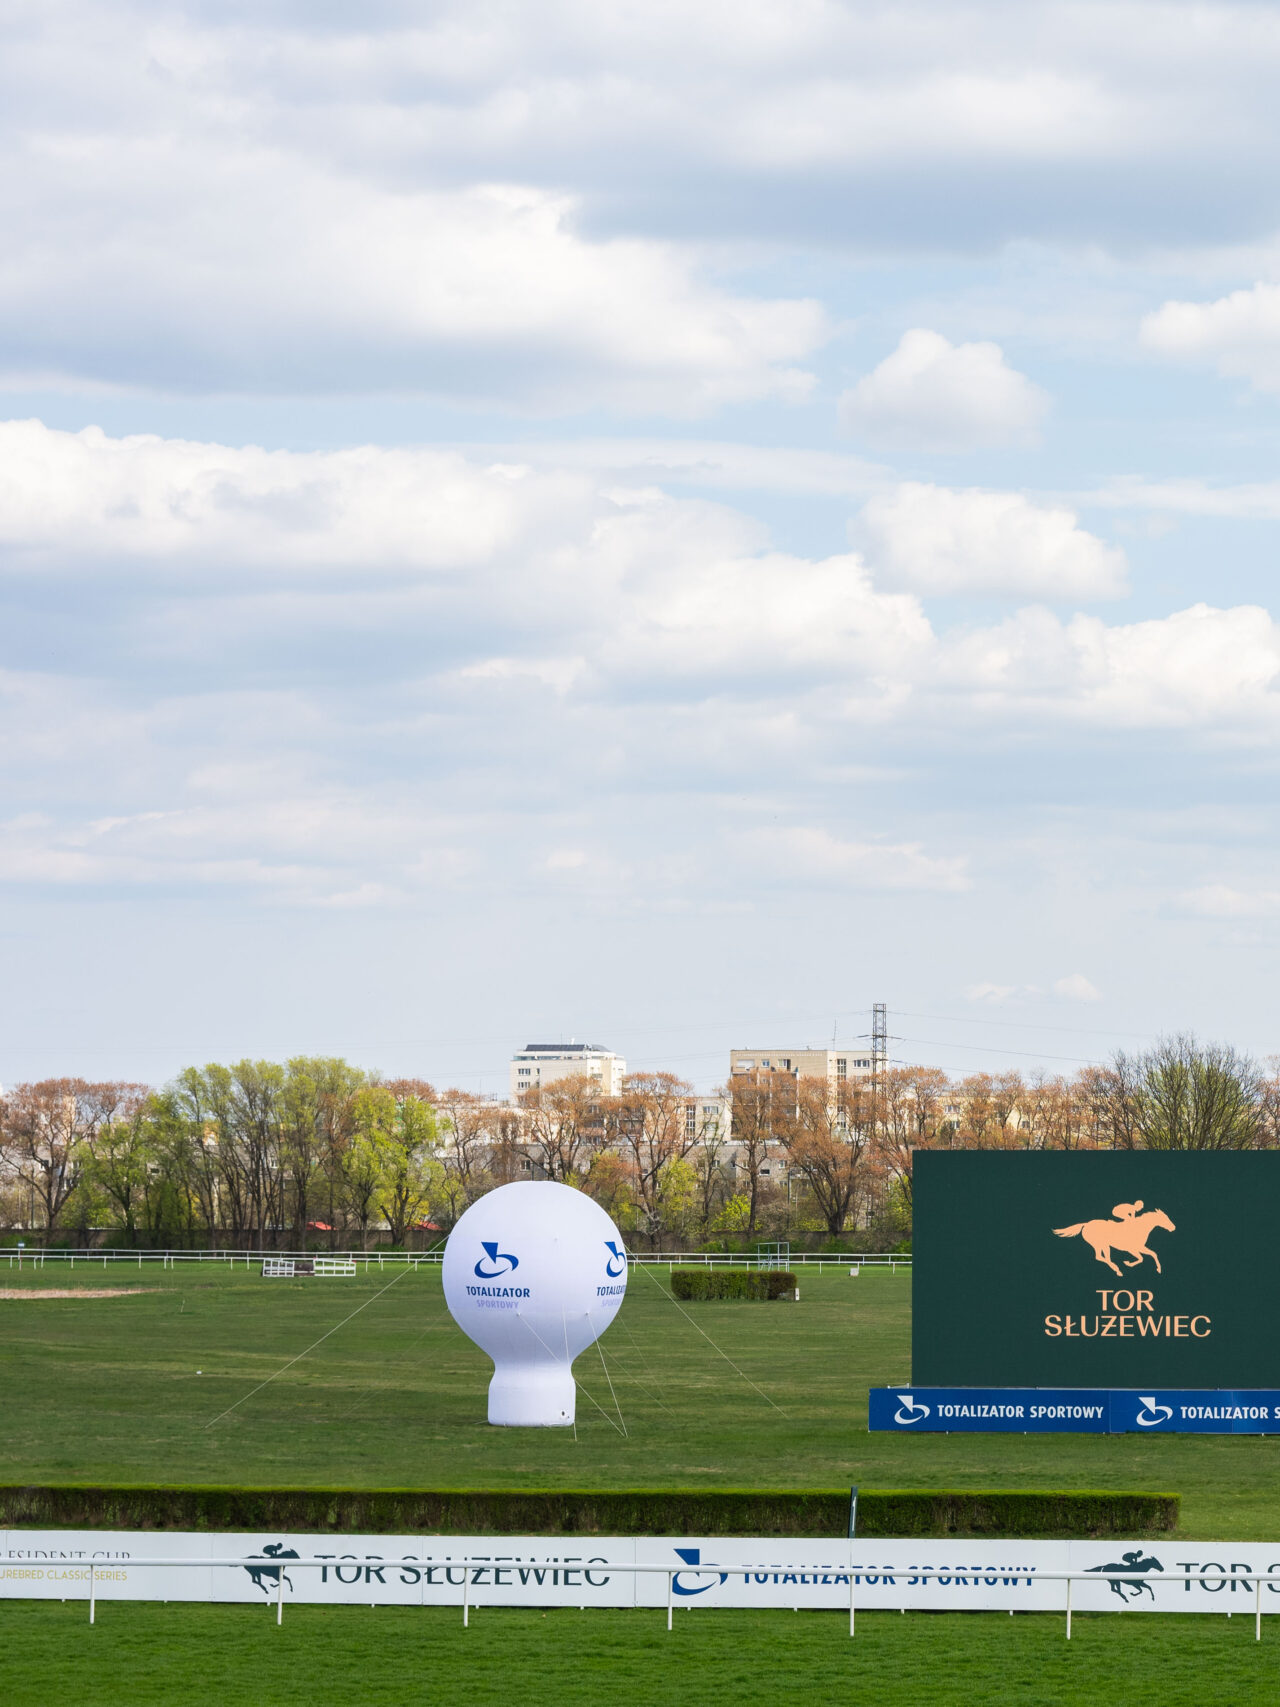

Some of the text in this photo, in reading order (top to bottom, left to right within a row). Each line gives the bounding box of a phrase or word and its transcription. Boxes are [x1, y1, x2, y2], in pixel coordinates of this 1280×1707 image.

[466, 1286, 530, 1298] TOTALIZATOR
[476, 1300, 519, 1309] SPORTOWY
[1096, 1290, 1154, 1311] TOR
[938, 1405, 1104, 1419] TOTALIZATOR SPORTOWY
[1180, 1406, 1268, 1419] TOTALIZATOR
[94, 1570, 128, 1581] SERIES
[314, 1555, 387, 1584] TOR
[742, 1564, 1036, 1586] TOTALIZATOR SPORTOWY
[1176, 1563, 1254, 1592] TOR
